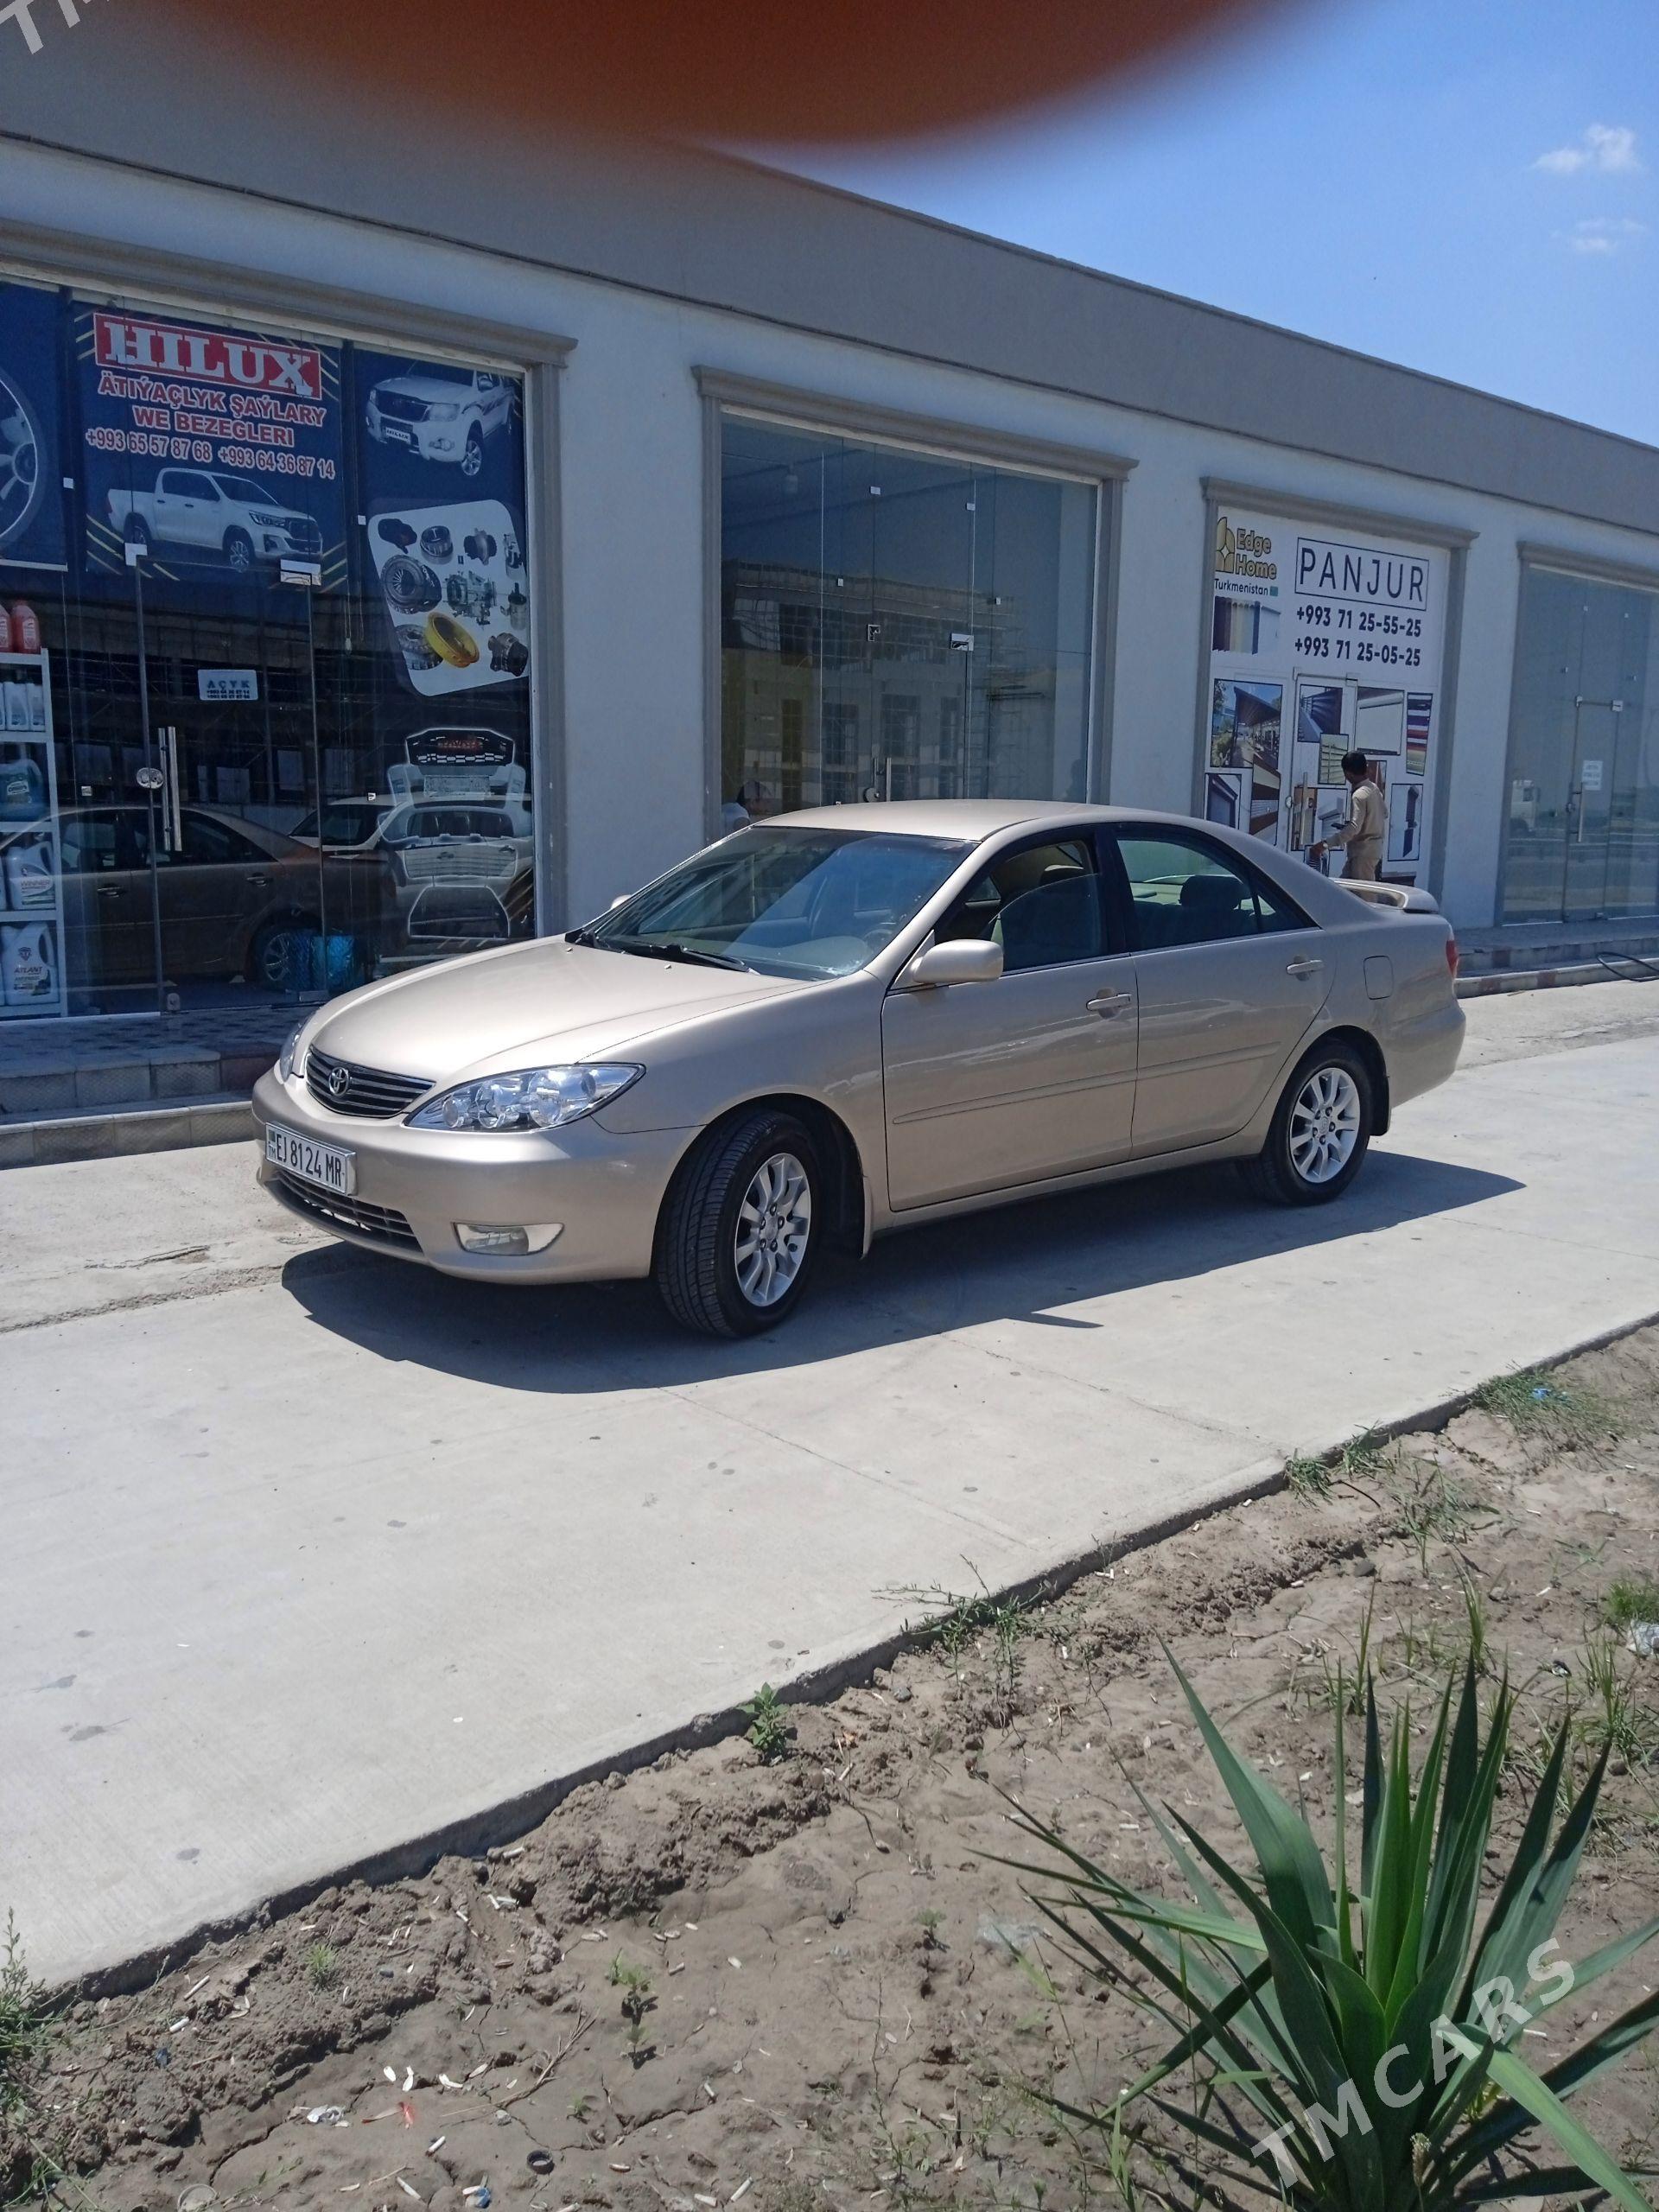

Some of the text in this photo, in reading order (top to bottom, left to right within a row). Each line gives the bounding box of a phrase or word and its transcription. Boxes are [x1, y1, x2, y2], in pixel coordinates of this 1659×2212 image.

[104, 321, 313, 397] HILUX
[133, 405, 295, 448] WE BEZEGLERI
[86, 428, 335, 480] +993 65 57 87 68 +993 64 36 87 14
[1236, 528, 1272, 557] Edge
[1235, 553, 1277, 580] Home
[1300, 547, 1424, 601] PANJUR
[1214, 579, 1268, 595] Turkmenistan
[1297, 605, 1421, 638] +993 71 25-55-25
[1295, 636, 1421, 666] +993 71 25-05-25
[276, 1134, 341, 1187] EJ 8124 MR
